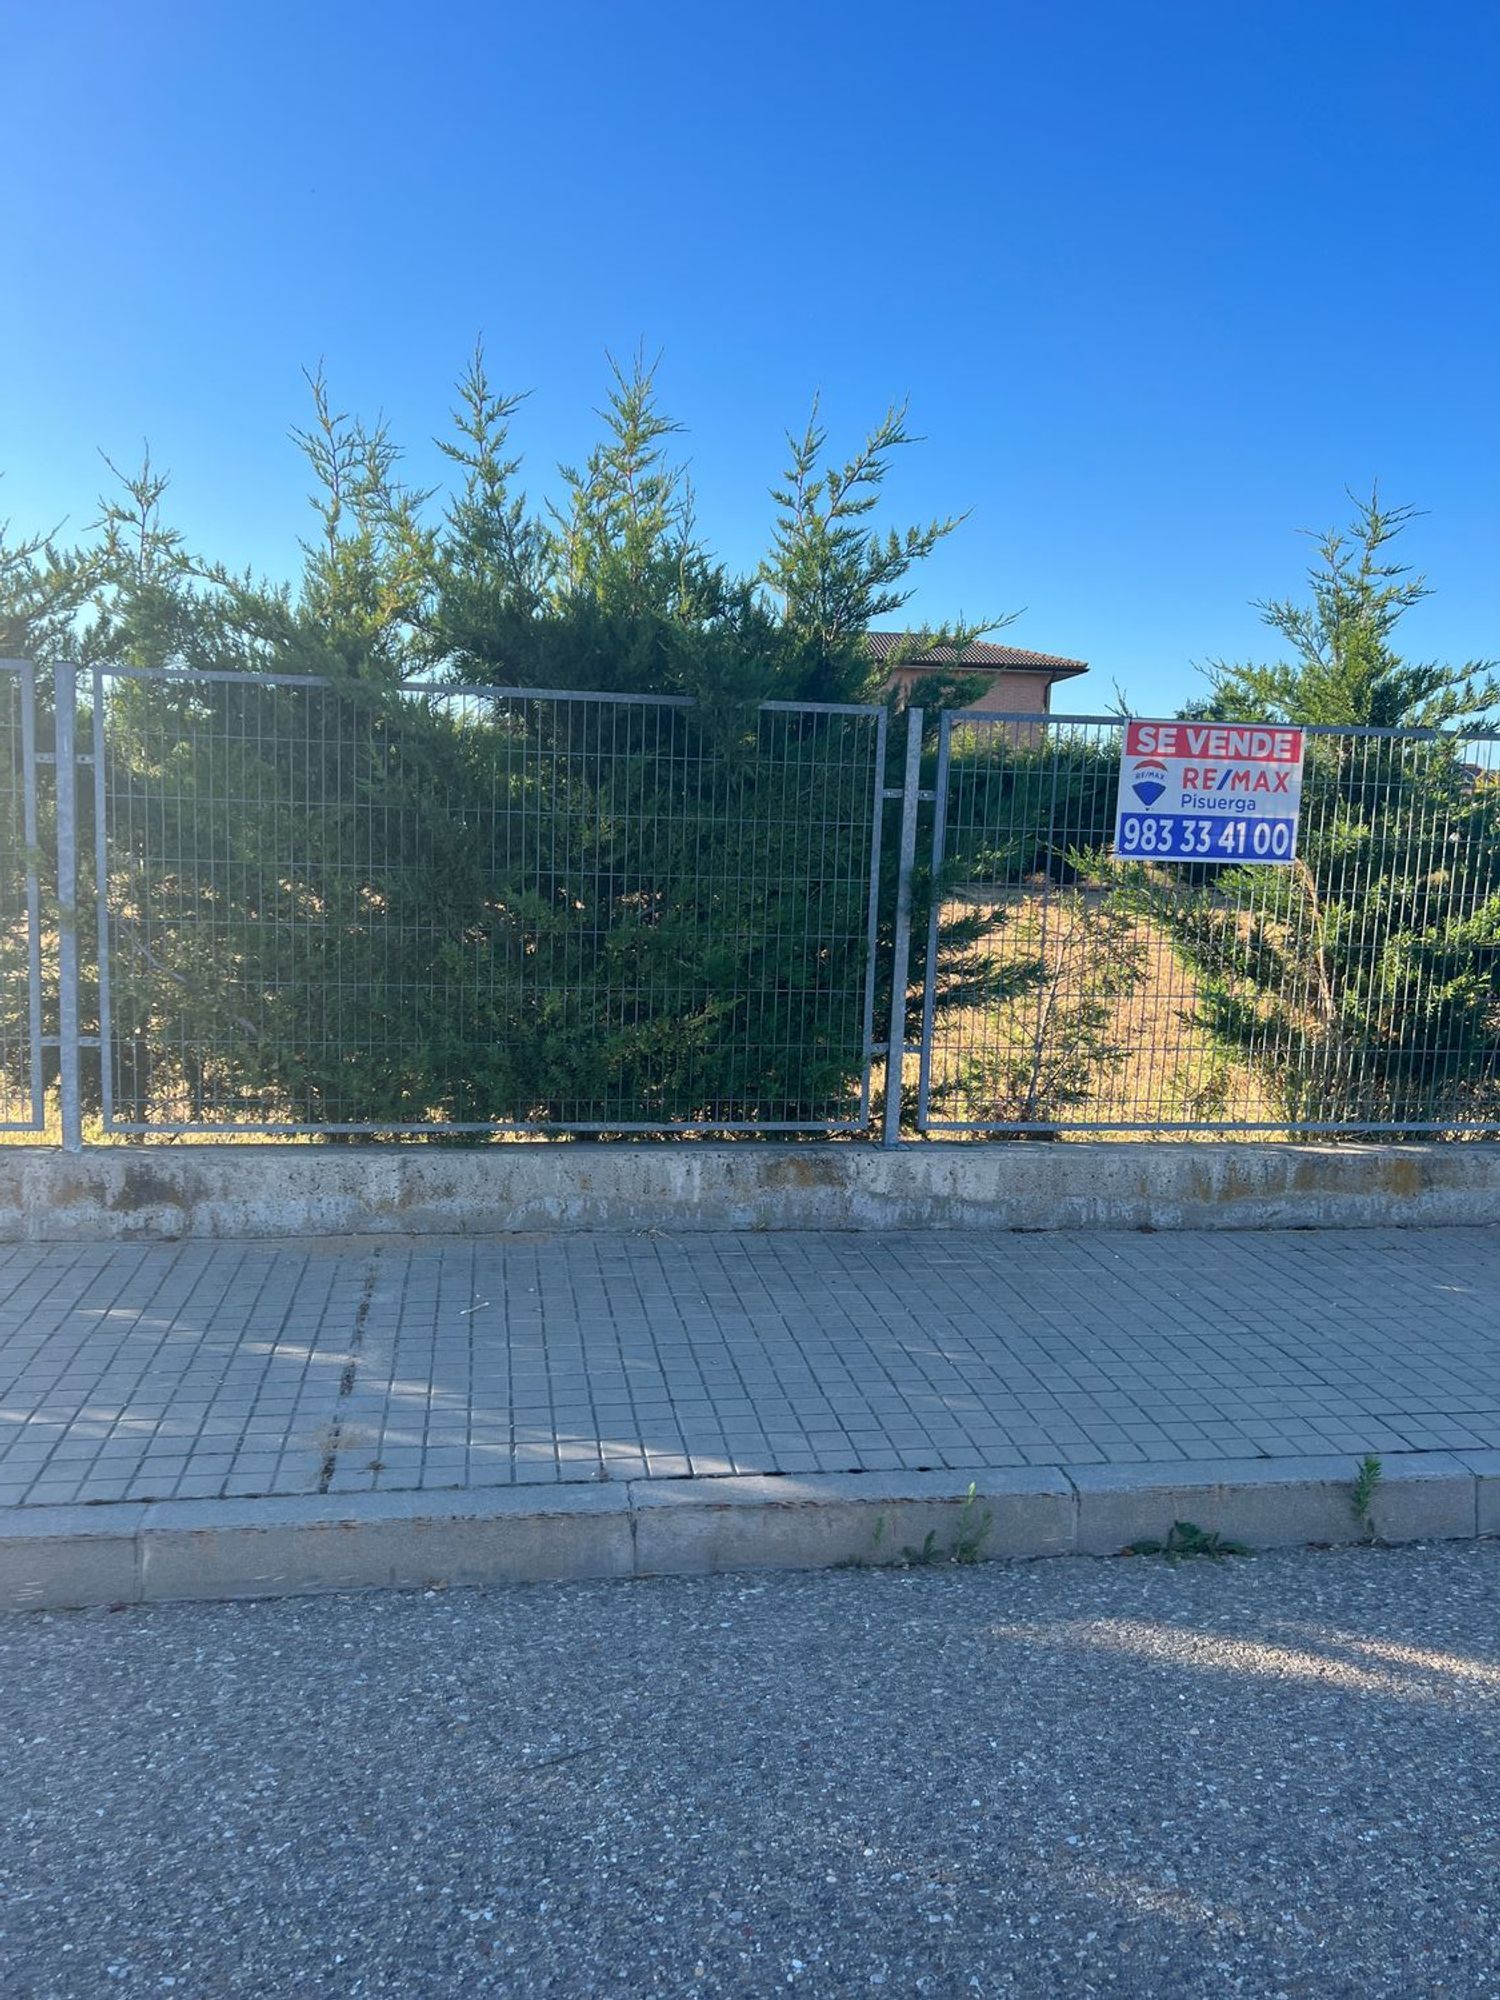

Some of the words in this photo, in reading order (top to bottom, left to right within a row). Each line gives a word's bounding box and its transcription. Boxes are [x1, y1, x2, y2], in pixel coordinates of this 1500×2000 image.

[1136, 726, 1177, 753] SE
[1186, 728, 1293, 759] VENDE
[1182, 767, 1290, 793] RE/MAX
[1181, 794, 1256, 813] Pisuerga
[1123, 818, 1174, 851] 983
[1180, 820, 1212, 853] 33
[1218, 821, 1246, 854] 41
[1253, 822, 1289, 856] 00
